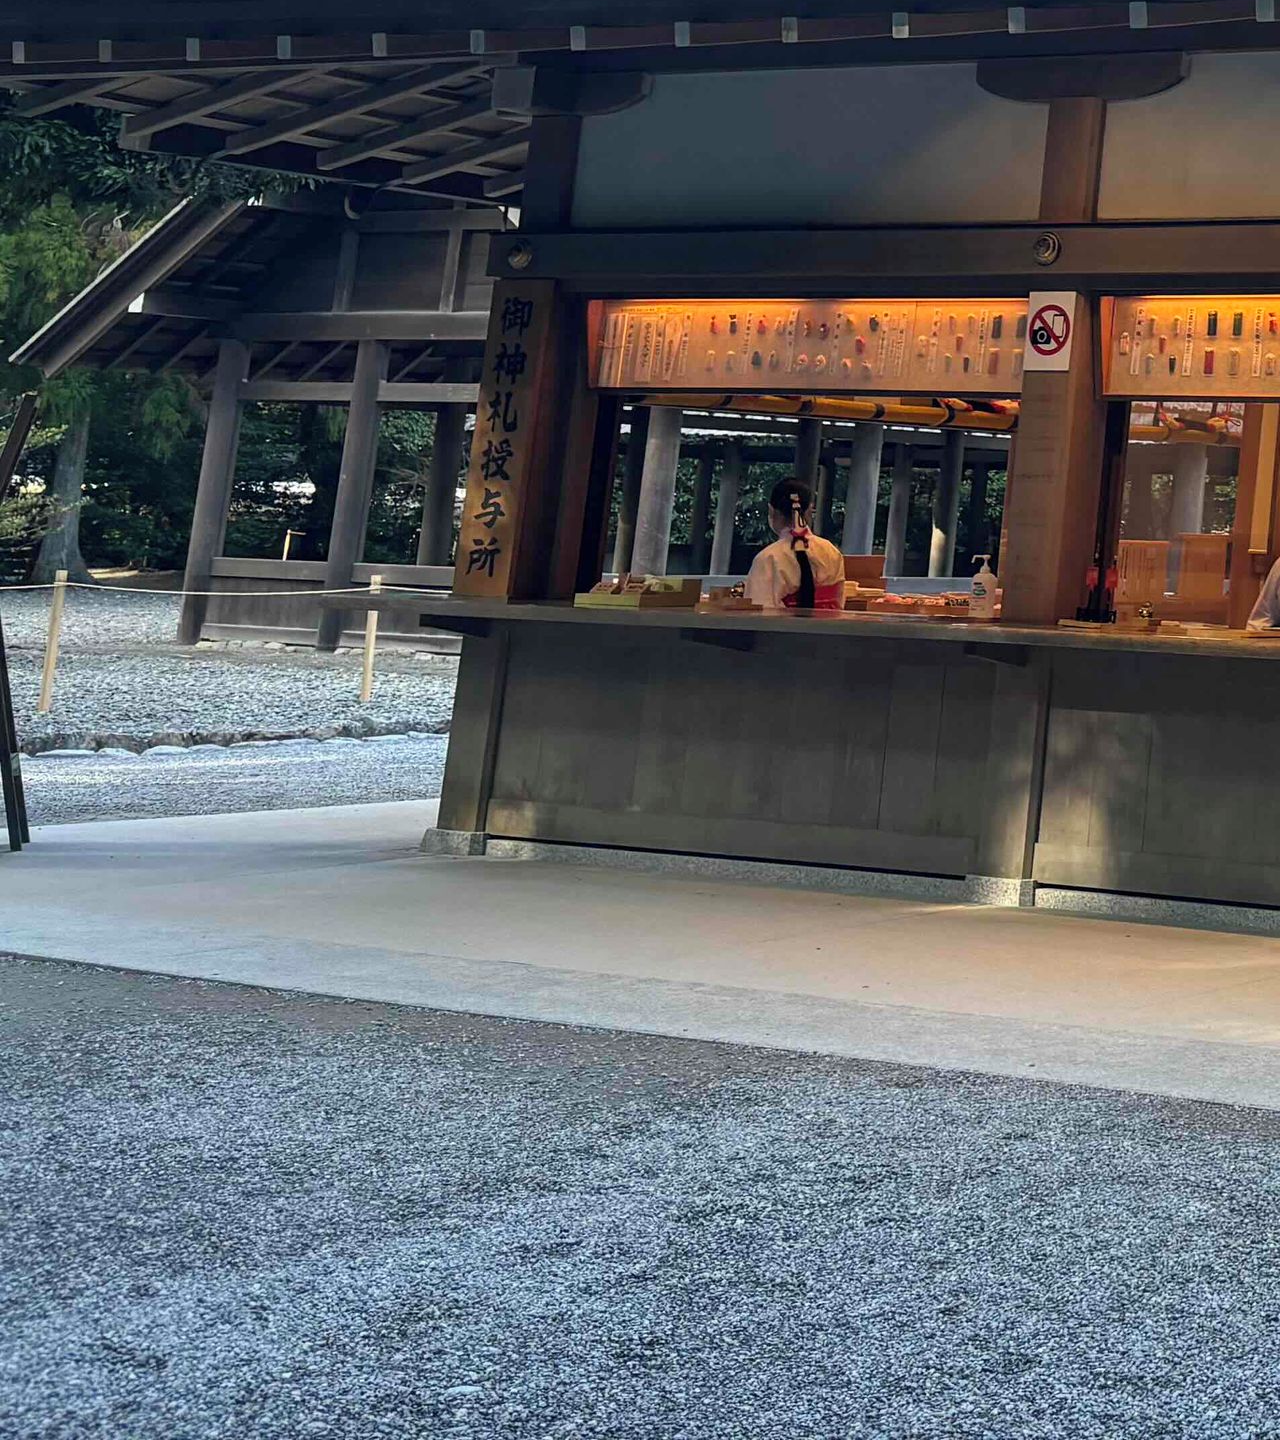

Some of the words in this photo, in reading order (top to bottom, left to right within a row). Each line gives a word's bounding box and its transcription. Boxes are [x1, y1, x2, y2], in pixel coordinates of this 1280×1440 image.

[464, 296, 534, 578] 御神札授与所
